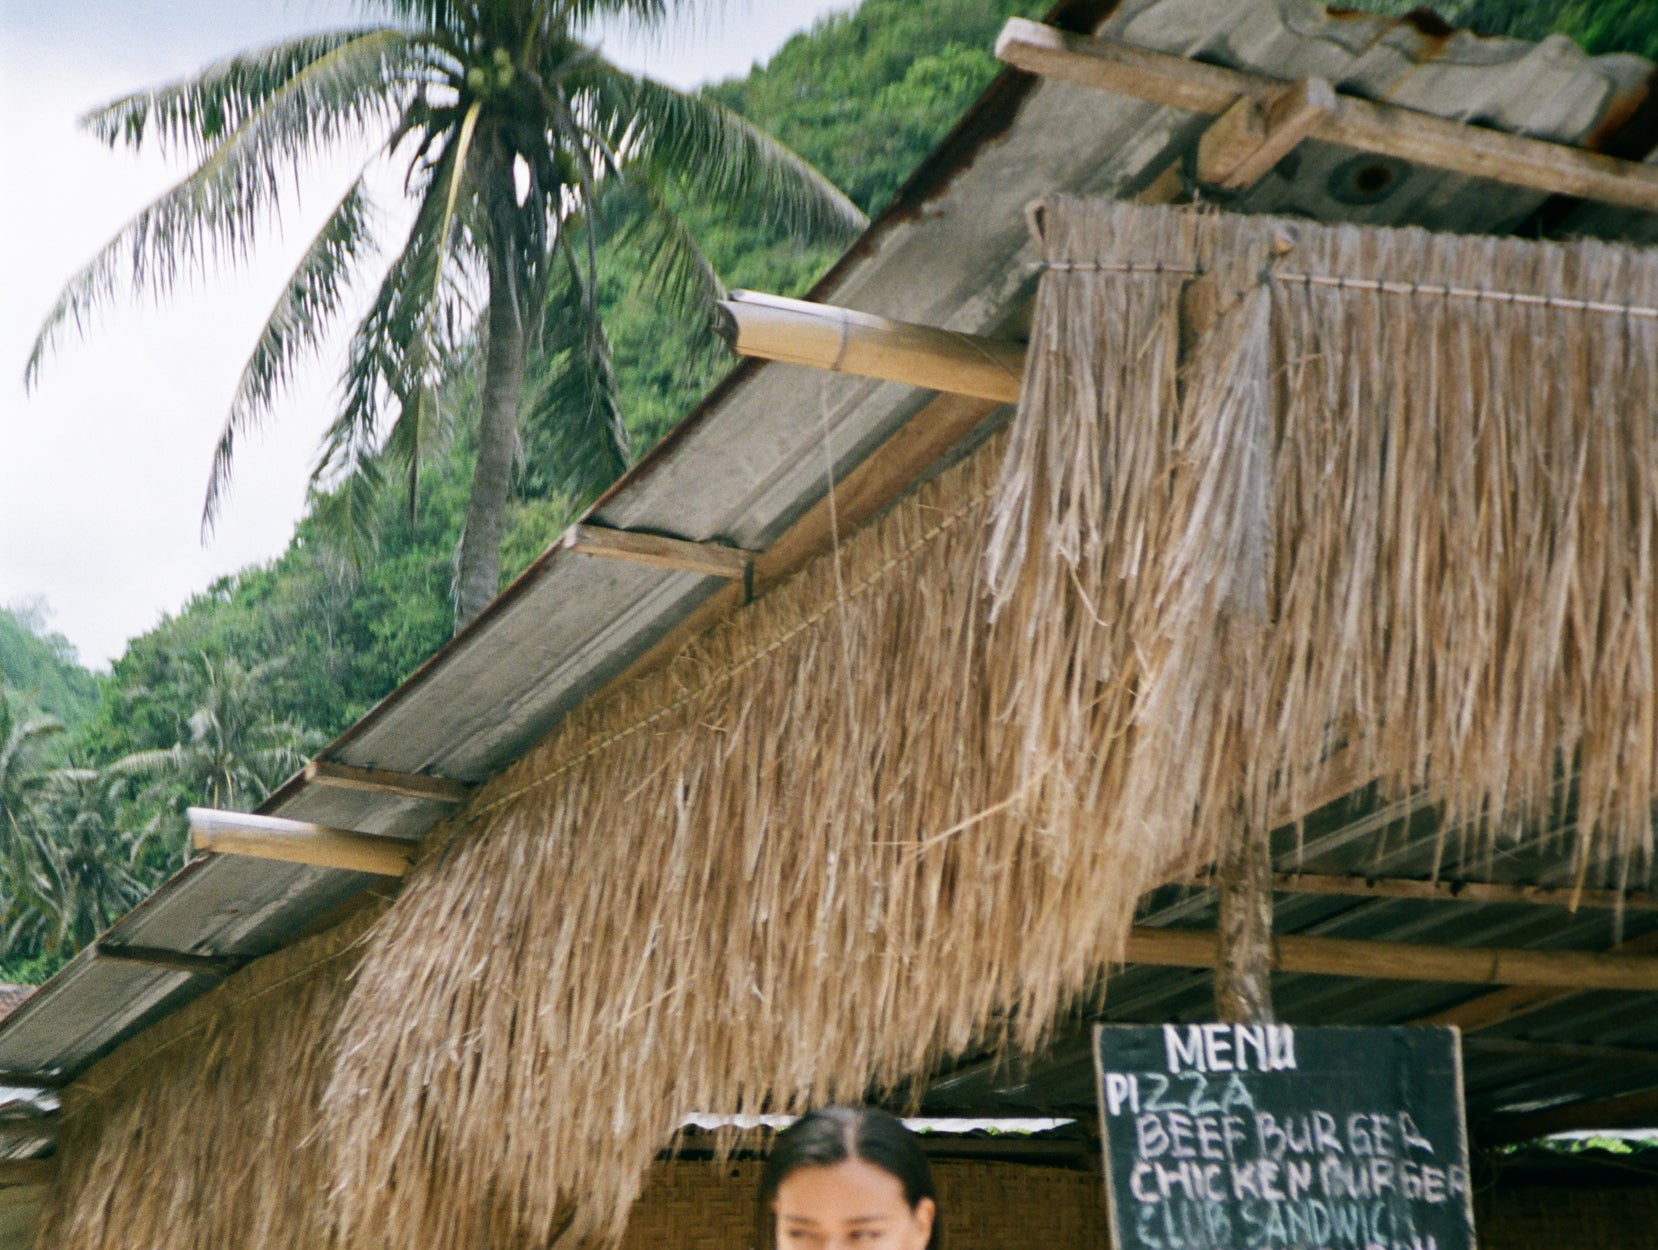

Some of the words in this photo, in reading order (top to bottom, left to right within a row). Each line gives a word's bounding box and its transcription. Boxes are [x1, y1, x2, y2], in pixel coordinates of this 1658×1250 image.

[1162, 1025, 1297, 1073] MENU
[1105, 1071, 1255, 1116] PIZZA
[1136, 1112, 1246, 1160] BEEF
[1255, 1110, 1434, 1161] BURGER
[1130, 1158, 1311, 1203] CHICKEN
[1320, 1155, 1469, 1202] BURGER
[1136, 1200, 1233, 1250] CLUB
